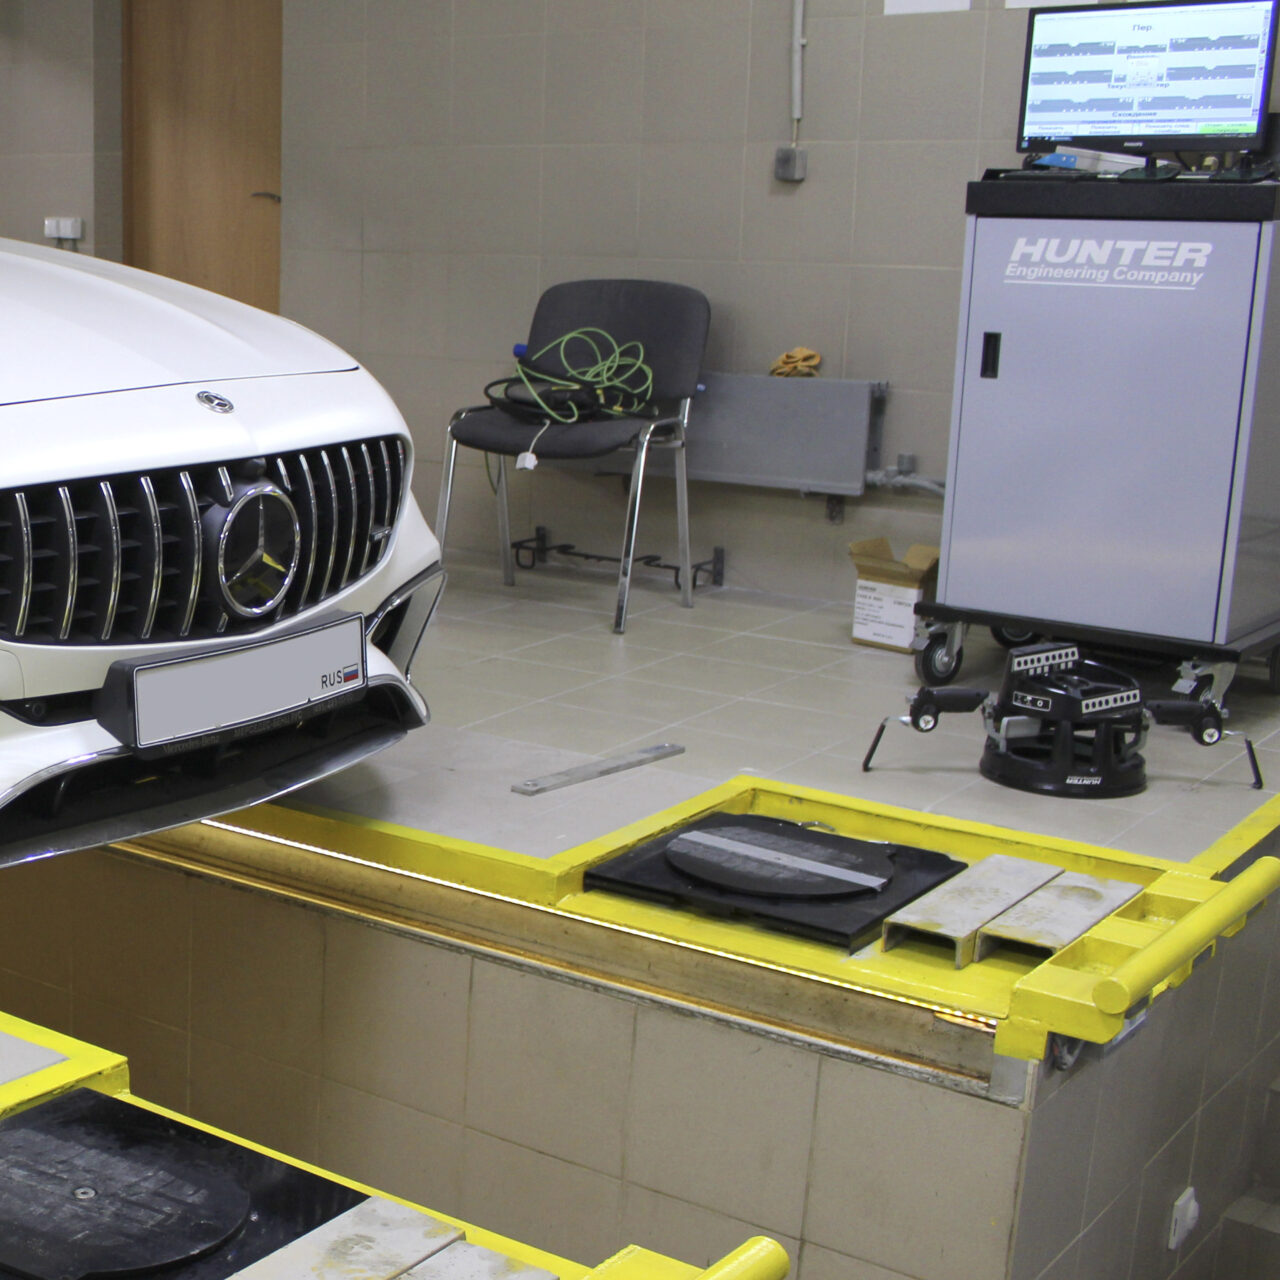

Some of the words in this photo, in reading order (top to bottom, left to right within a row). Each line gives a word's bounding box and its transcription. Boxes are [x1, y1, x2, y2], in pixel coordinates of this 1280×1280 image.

[1009, 237, 1213, 267] HUNTER
[1005, 263, 1108, 281] Engineering
[1112, 267, 1204, 285] Company
[321, 672, 343, 689] RUS
